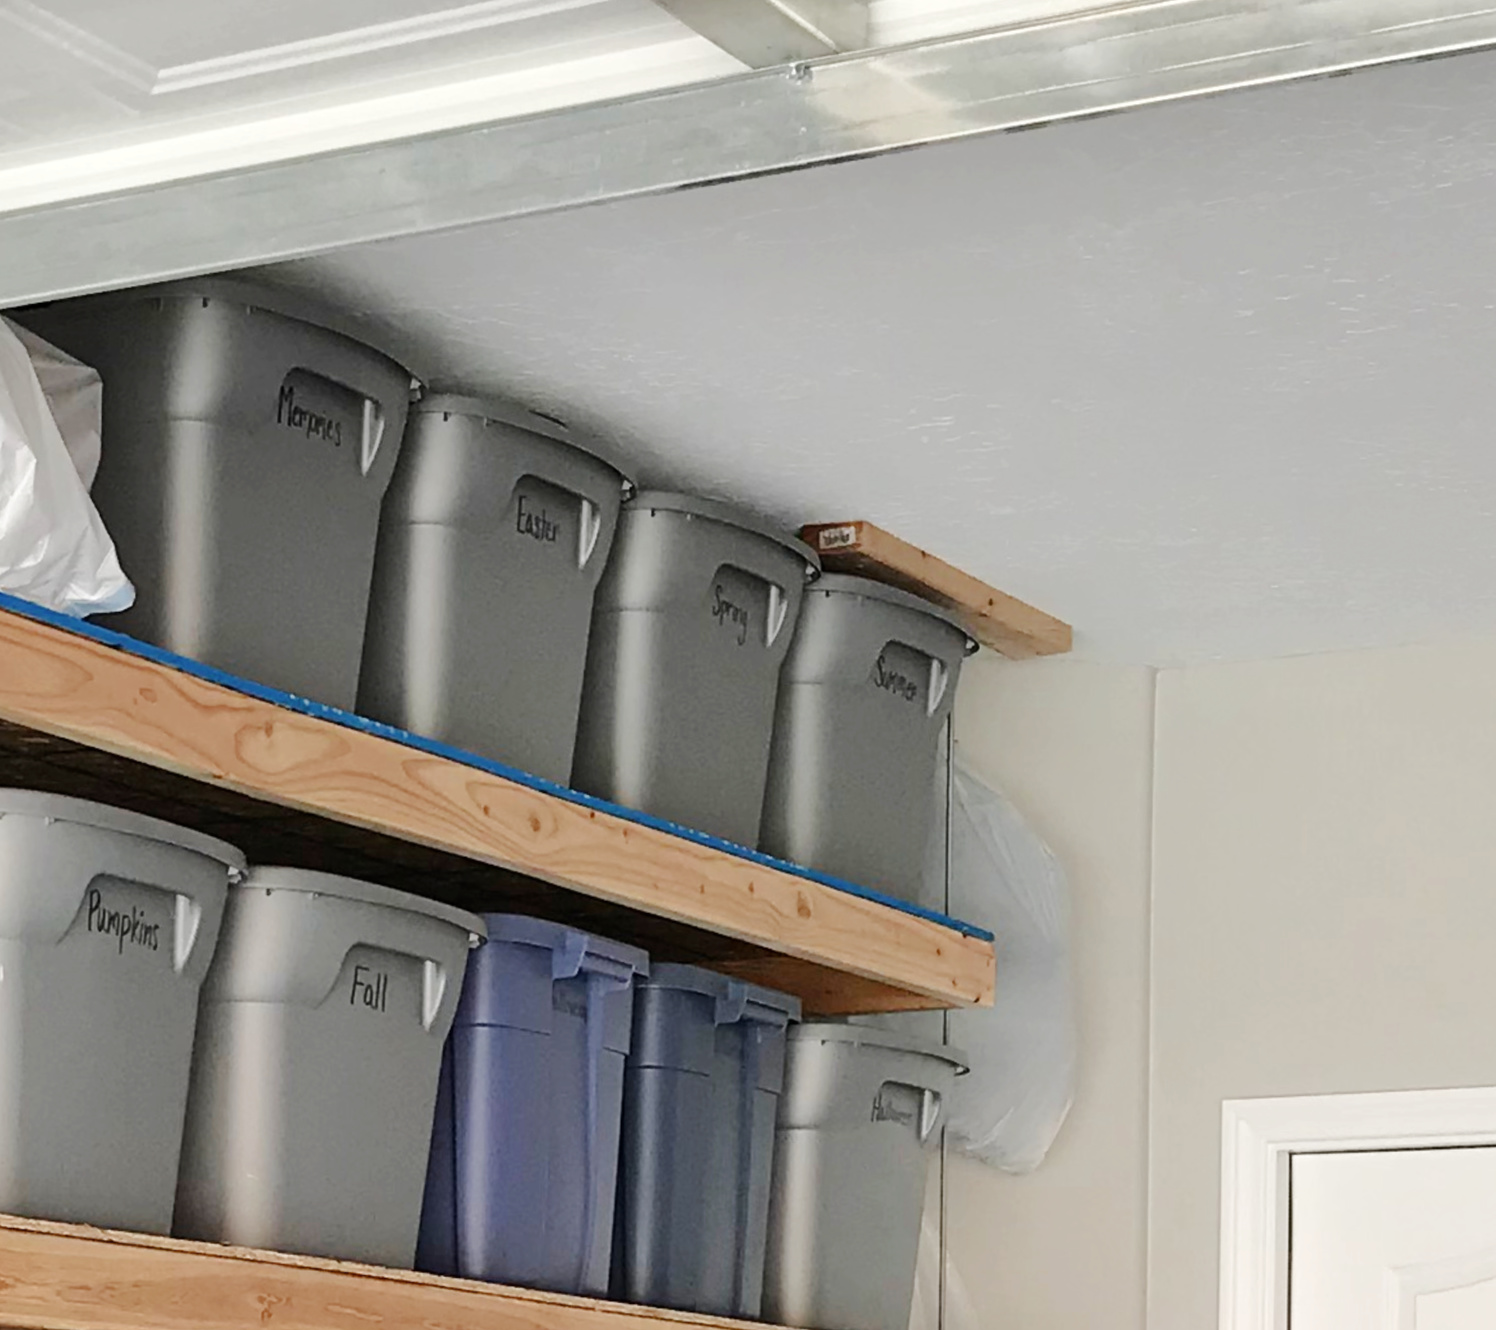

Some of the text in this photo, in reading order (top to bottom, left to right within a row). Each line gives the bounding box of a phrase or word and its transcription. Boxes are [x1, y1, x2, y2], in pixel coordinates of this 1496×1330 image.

[516, 495, 559, 542] Easter
[87, 889, 160, 954] Pumpkins
[350, 965, 387, 1012] Fall
